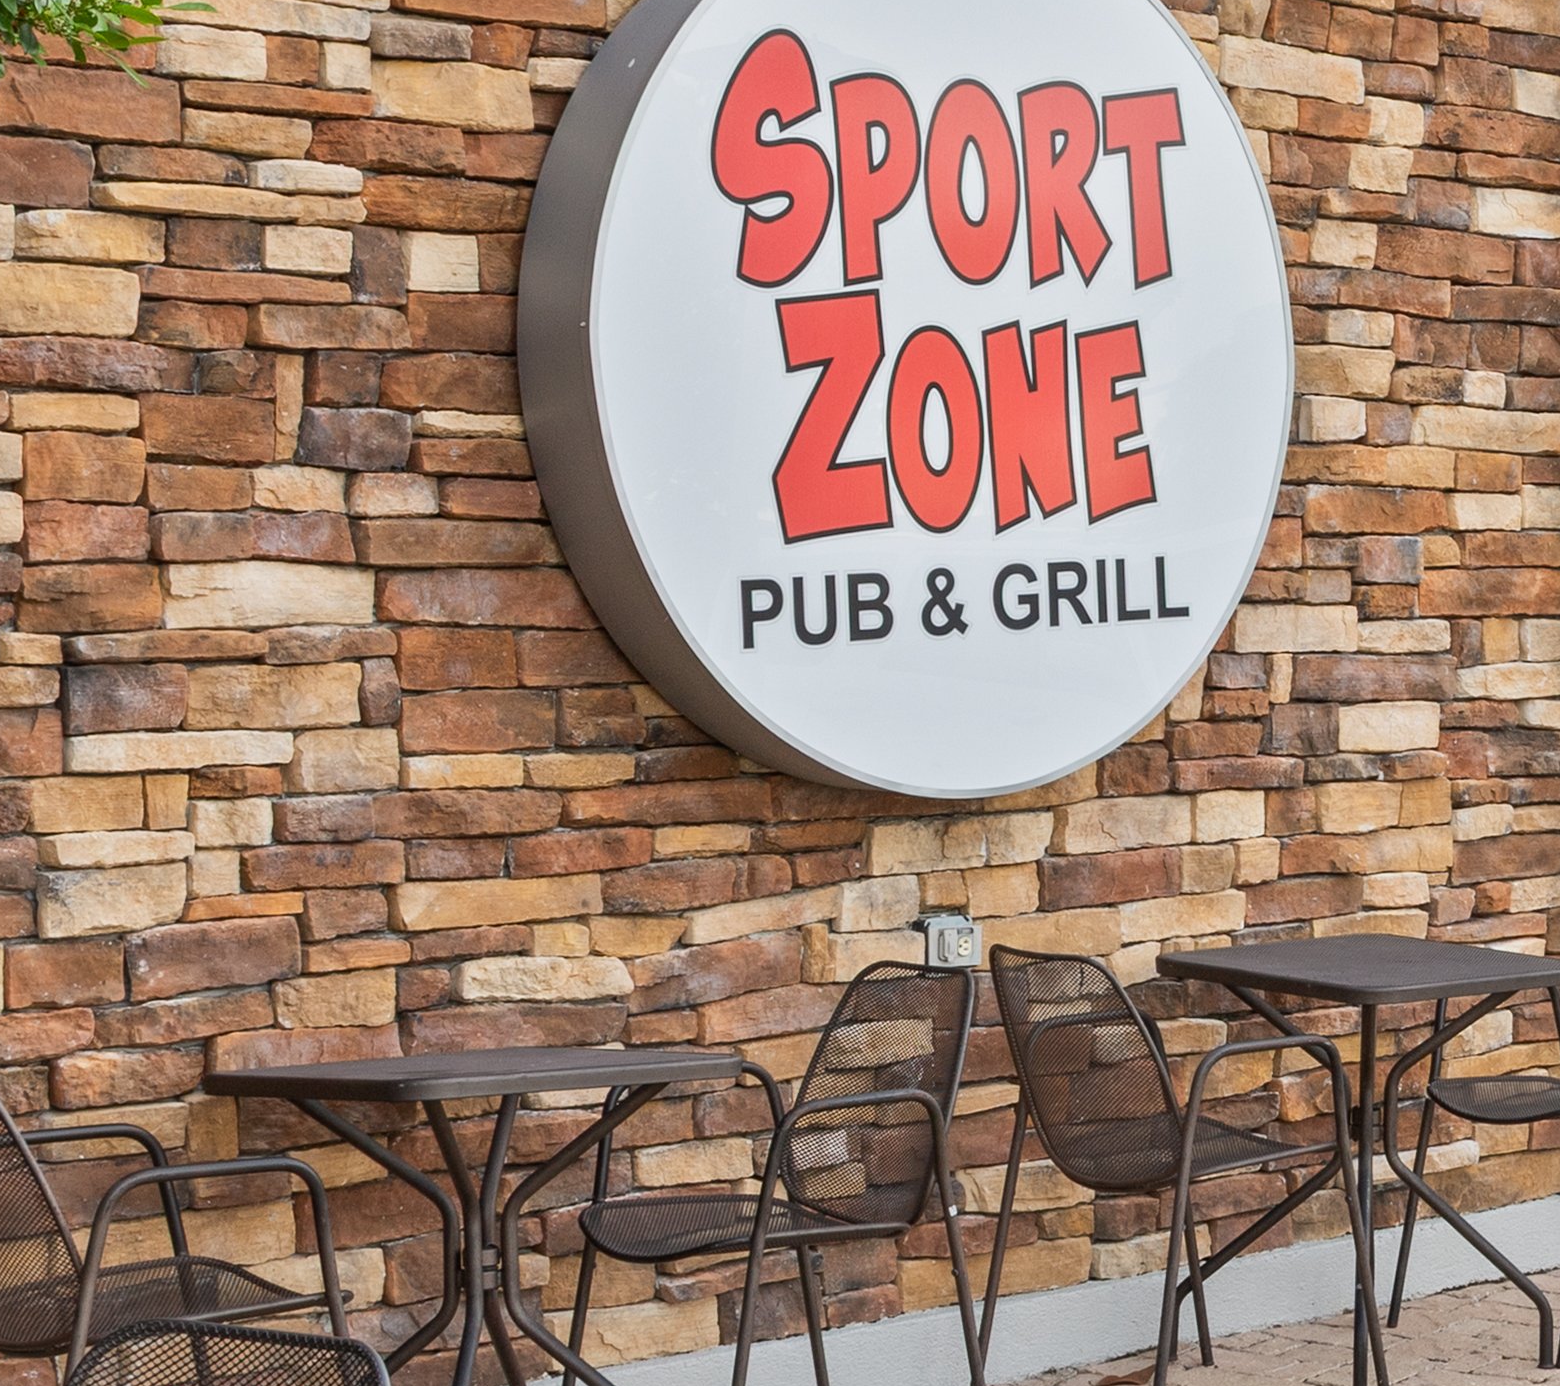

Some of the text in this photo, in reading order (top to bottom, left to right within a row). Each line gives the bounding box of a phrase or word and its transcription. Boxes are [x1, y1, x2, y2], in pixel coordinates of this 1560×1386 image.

[710, 28, 1186, 290] SPORT
[771, 288, 1158, 545] ZONE
[740, 556, 1190, 649] PUB & GRILL
